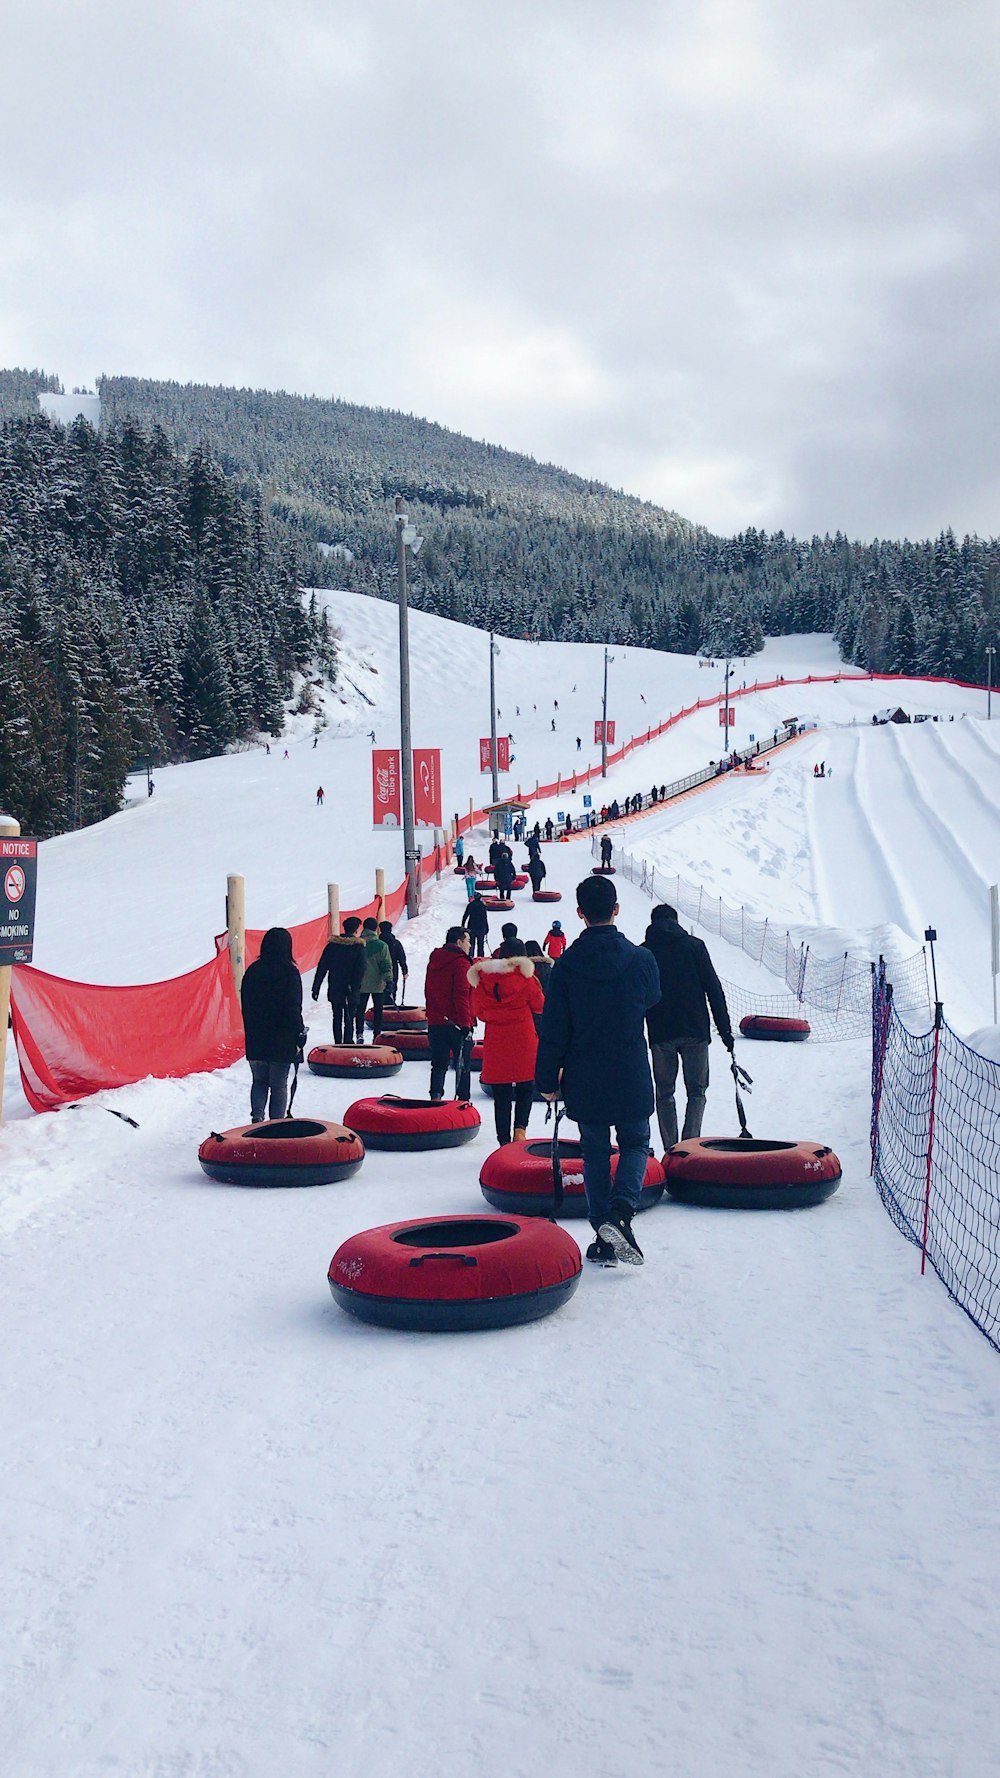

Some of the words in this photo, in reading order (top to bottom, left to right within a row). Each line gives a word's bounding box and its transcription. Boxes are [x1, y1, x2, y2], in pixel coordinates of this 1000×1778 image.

[389, 756, 397, 774] park
[3, 843, 29, 855] NOTICE
[9, 909, 19, 921] NO
